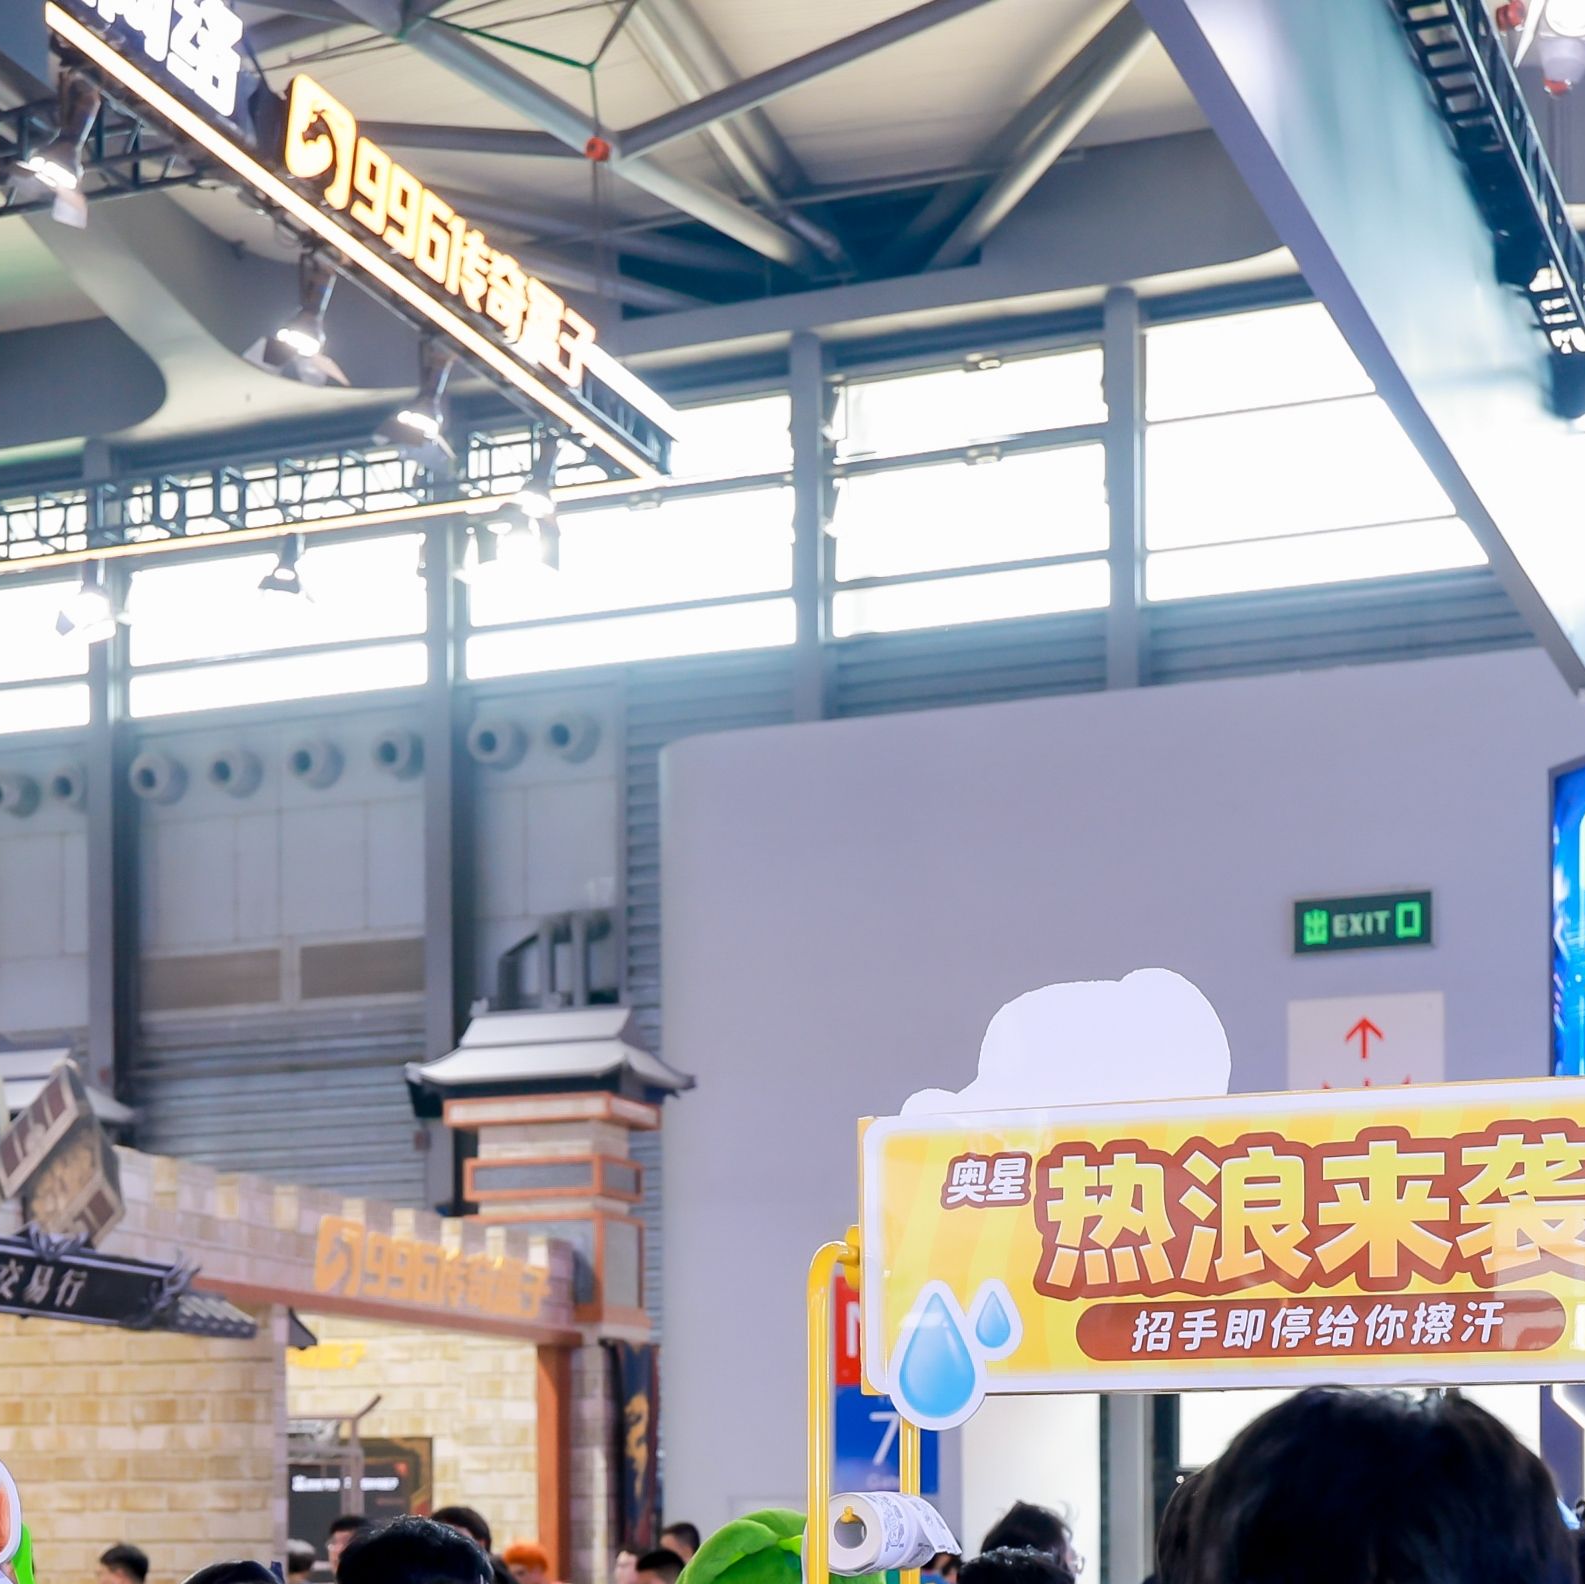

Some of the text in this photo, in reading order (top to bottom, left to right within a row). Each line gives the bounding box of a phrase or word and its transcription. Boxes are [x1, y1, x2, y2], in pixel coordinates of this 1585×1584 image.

[1332, 909, 1391, 938] EXIT
[946, 1155, 1027, 1204] 奥星
[1131, 1300, 1506, 1352] 招手即停给你擦汗
[869, 1410, 901, 1466] 7
